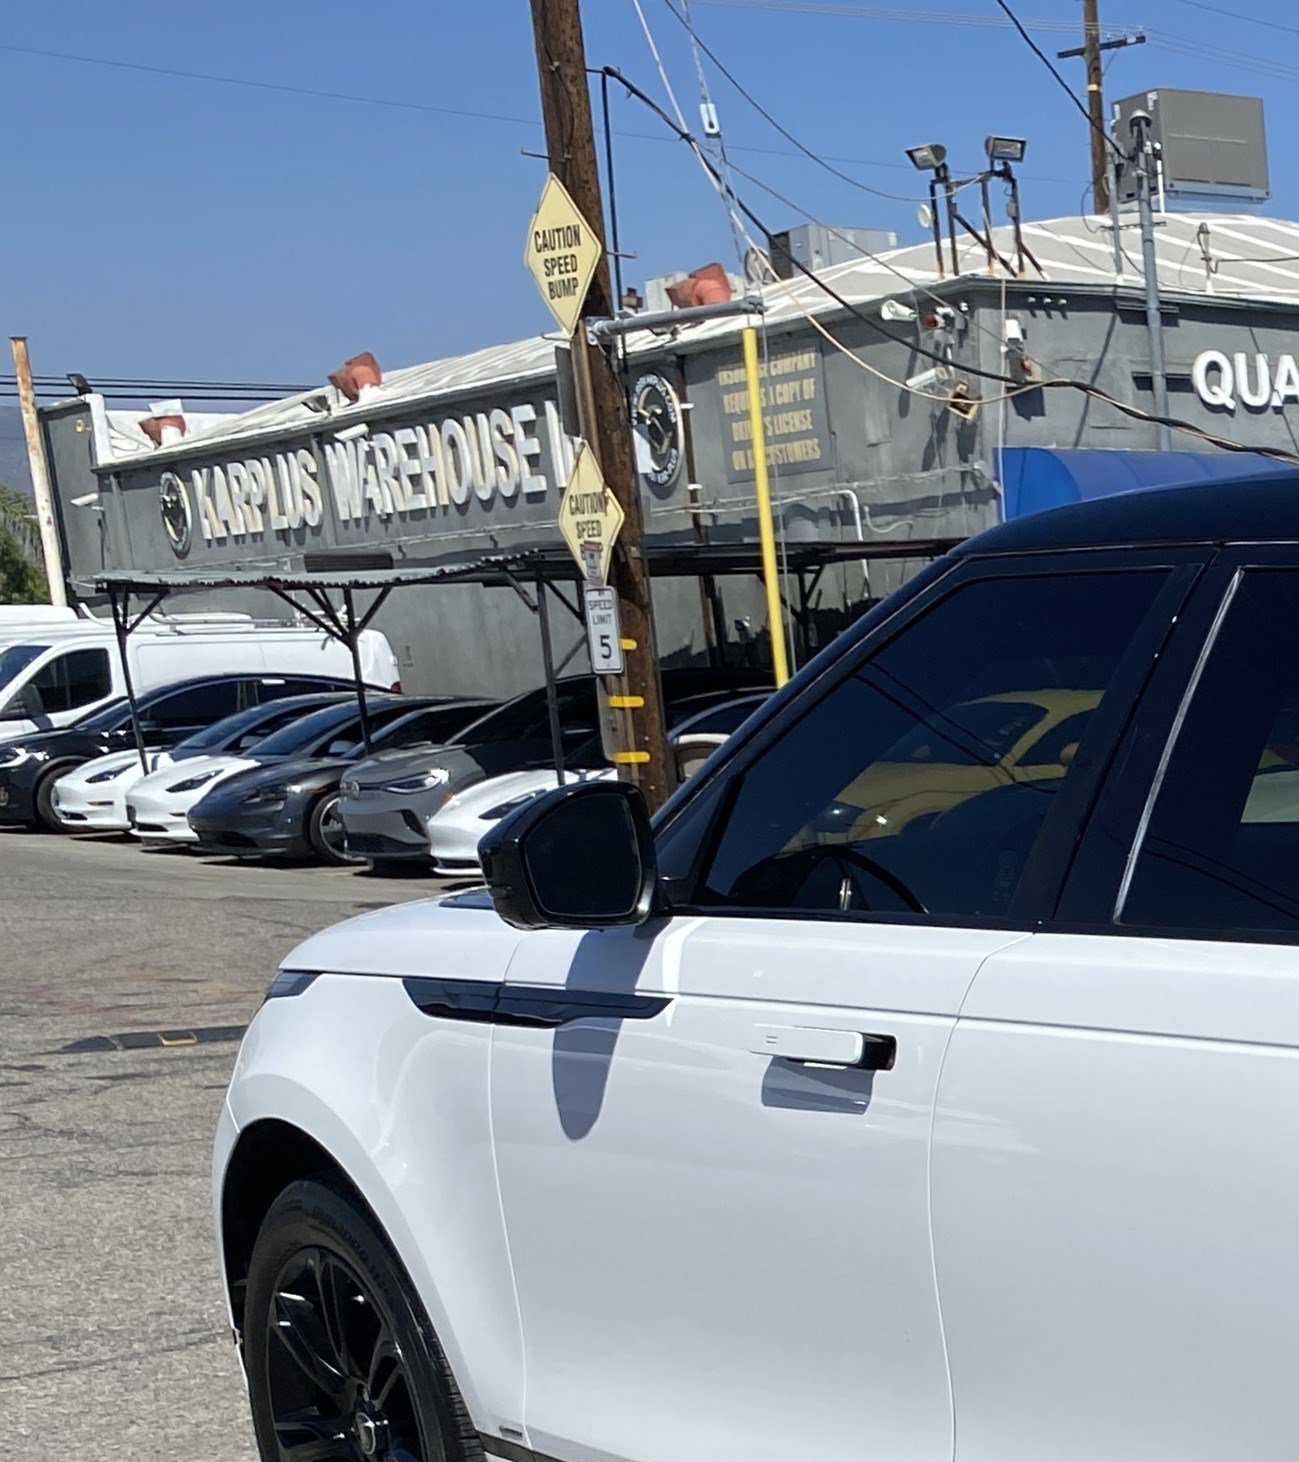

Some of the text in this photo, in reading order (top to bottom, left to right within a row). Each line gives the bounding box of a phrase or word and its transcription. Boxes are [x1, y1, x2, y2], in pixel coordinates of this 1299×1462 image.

[534, 224, 581, 253] CAUTION
[543, 254, 578, 277] SPEED
[547, 277, 579, 300] BUMP
[191, 448, 323, 541] KARPLUS
[324, 403, 547, 521] WAREHOUSE
[569, 492, 606, 516] CAUTION
[576, 519, 602, 539] SPEED
[588, 600, 613, 611] SPEED
[592, 613, 612, 626] LIMIT
[600, 635, 612, 660] 5
